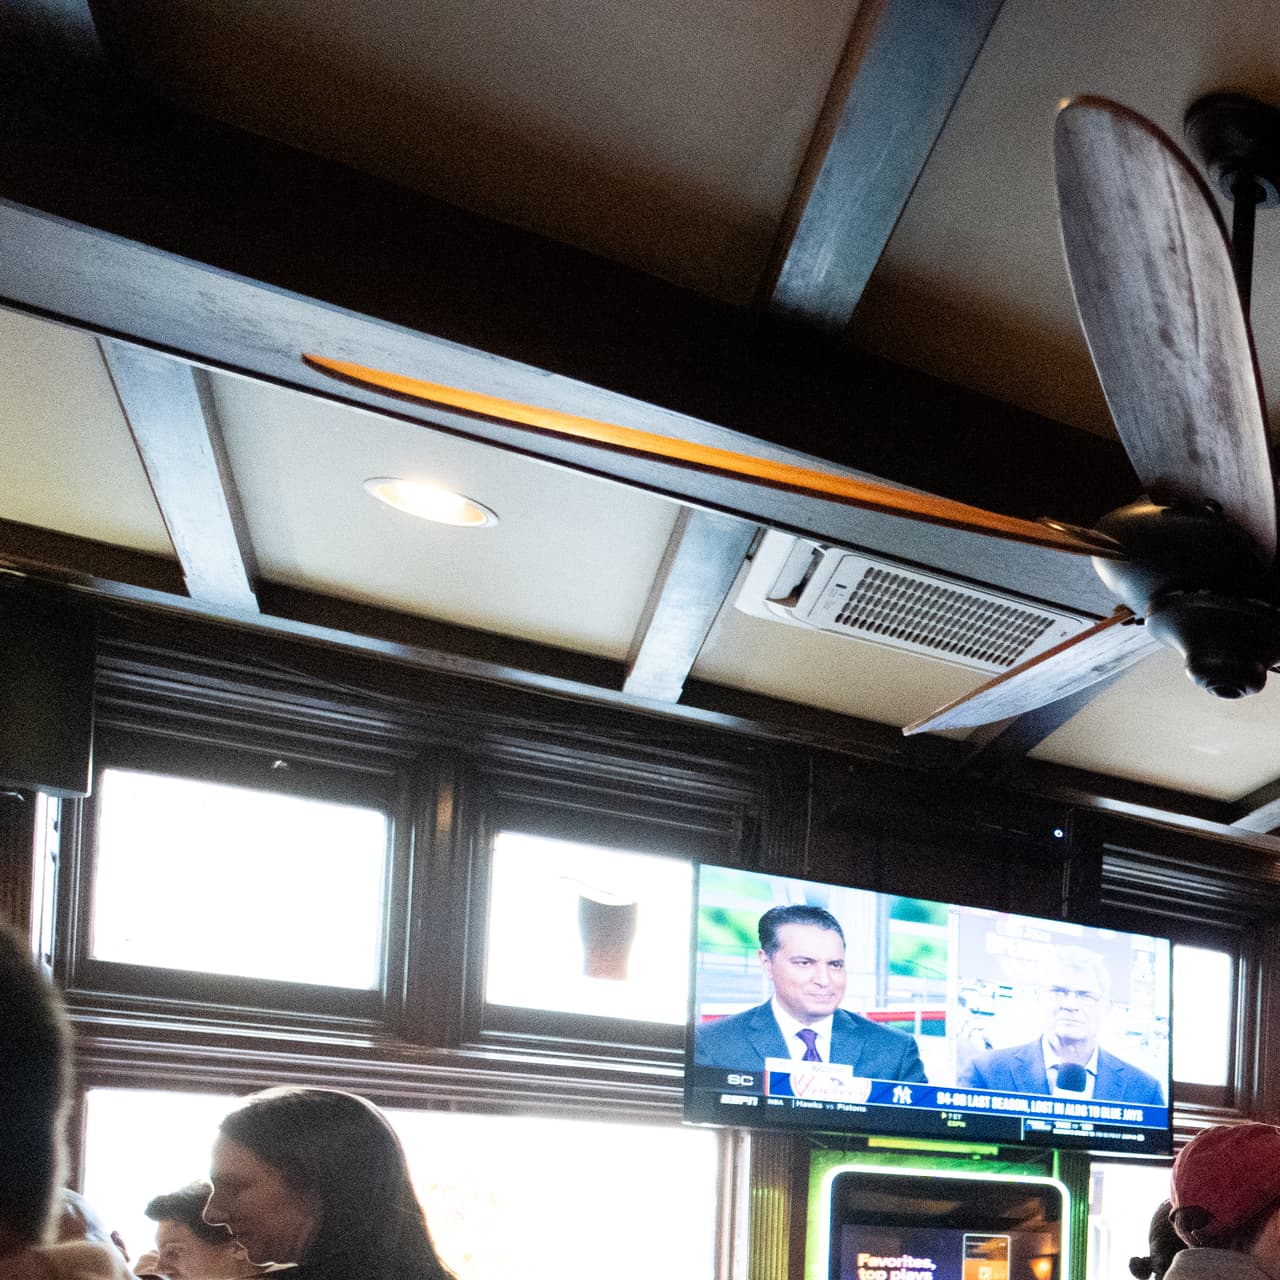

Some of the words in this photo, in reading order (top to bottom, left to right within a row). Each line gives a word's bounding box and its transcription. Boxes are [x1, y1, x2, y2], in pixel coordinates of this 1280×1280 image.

[727, 1074, 754, 1086] SC
[720, 1094, 758, 1106] ESPN
[796, 1100, 823, 1109] Hawks
[837, 1103, 867, 1112] Pistons
[968, 1094, 990, 1108] LAST
[1031, 1100, 1053, 1113] LOST
[1054, 1102, 1064, 1115] IN
[1089, 1105, 1100, 1118] TO
[1101, 1107, 1122, 1119] BLUE
[1122, 1109, 1143, 1121] JAYS
[857, 1253, 936, 1271] Favorites,
